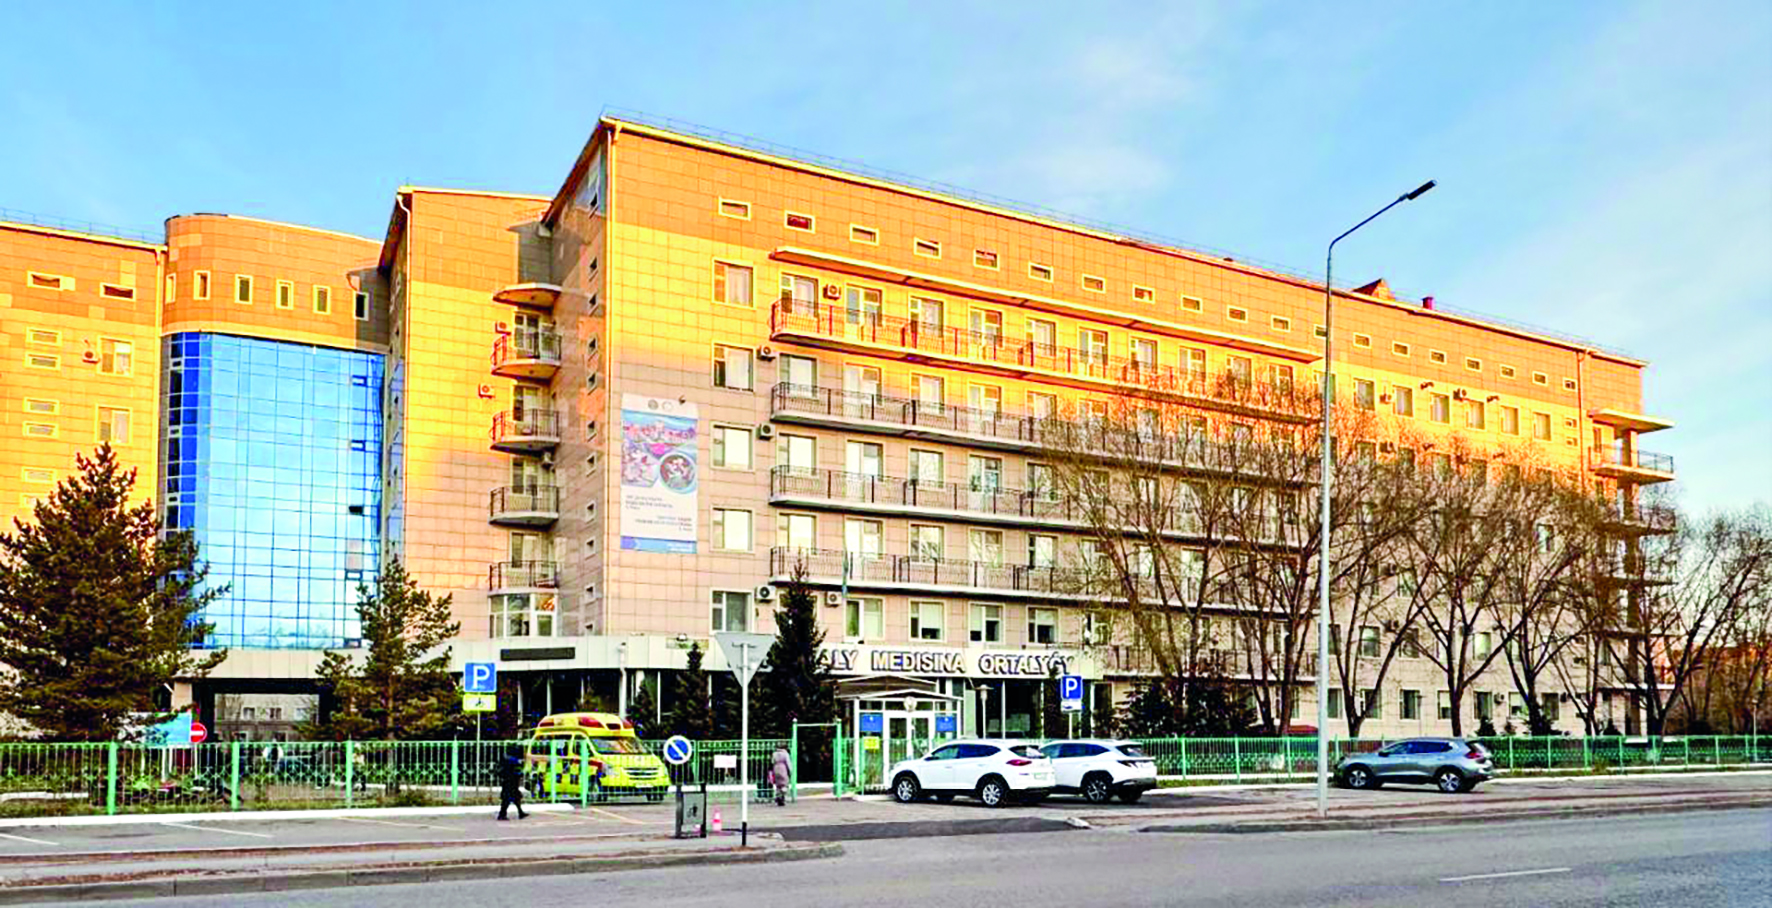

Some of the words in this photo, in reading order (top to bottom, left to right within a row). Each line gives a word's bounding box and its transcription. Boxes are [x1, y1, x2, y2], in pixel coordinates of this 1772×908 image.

[814, 648, 859, 671] ALY
[871, 649, 966, 674] MEDISINA
[473, 665, 490, 689] P
[1065, 677, 1078, 699] P
